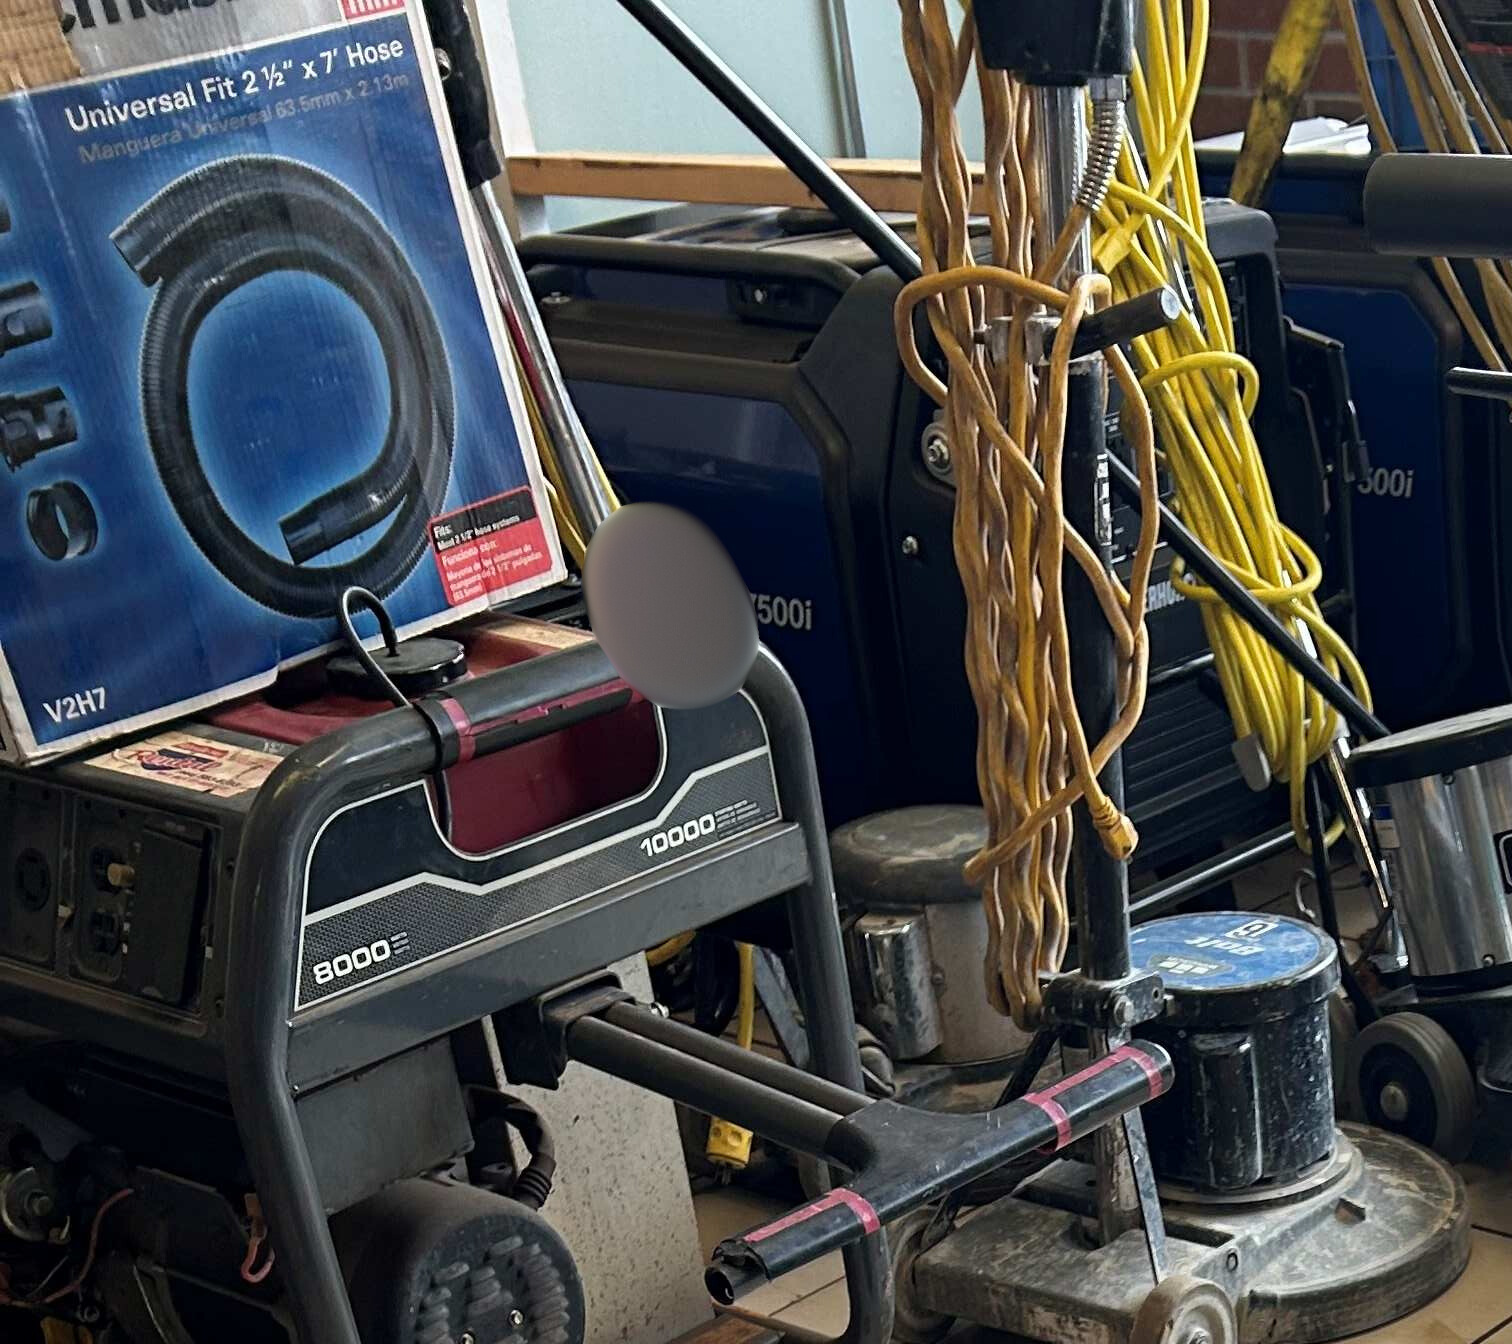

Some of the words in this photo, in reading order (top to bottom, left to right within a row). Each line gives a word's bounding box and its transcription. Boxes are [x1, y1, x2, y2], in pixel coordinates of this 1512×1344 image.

[64, 90, 196, 133] Universal
[201, 78, 234, 104] Fit
[242, 70, 259, 95] 2
[301, 63, 317, 79] x
[346, 38, 403, 67] Hose
[77, 130, 183, 164] Manguera
[186, 109, 272, 140] Universal
[343, 87, 355, 101] x
[42, 686, 106, 724] V2H7
[640, 813, 716, 857] 10000
[312, 939, 392, 985] 8000
